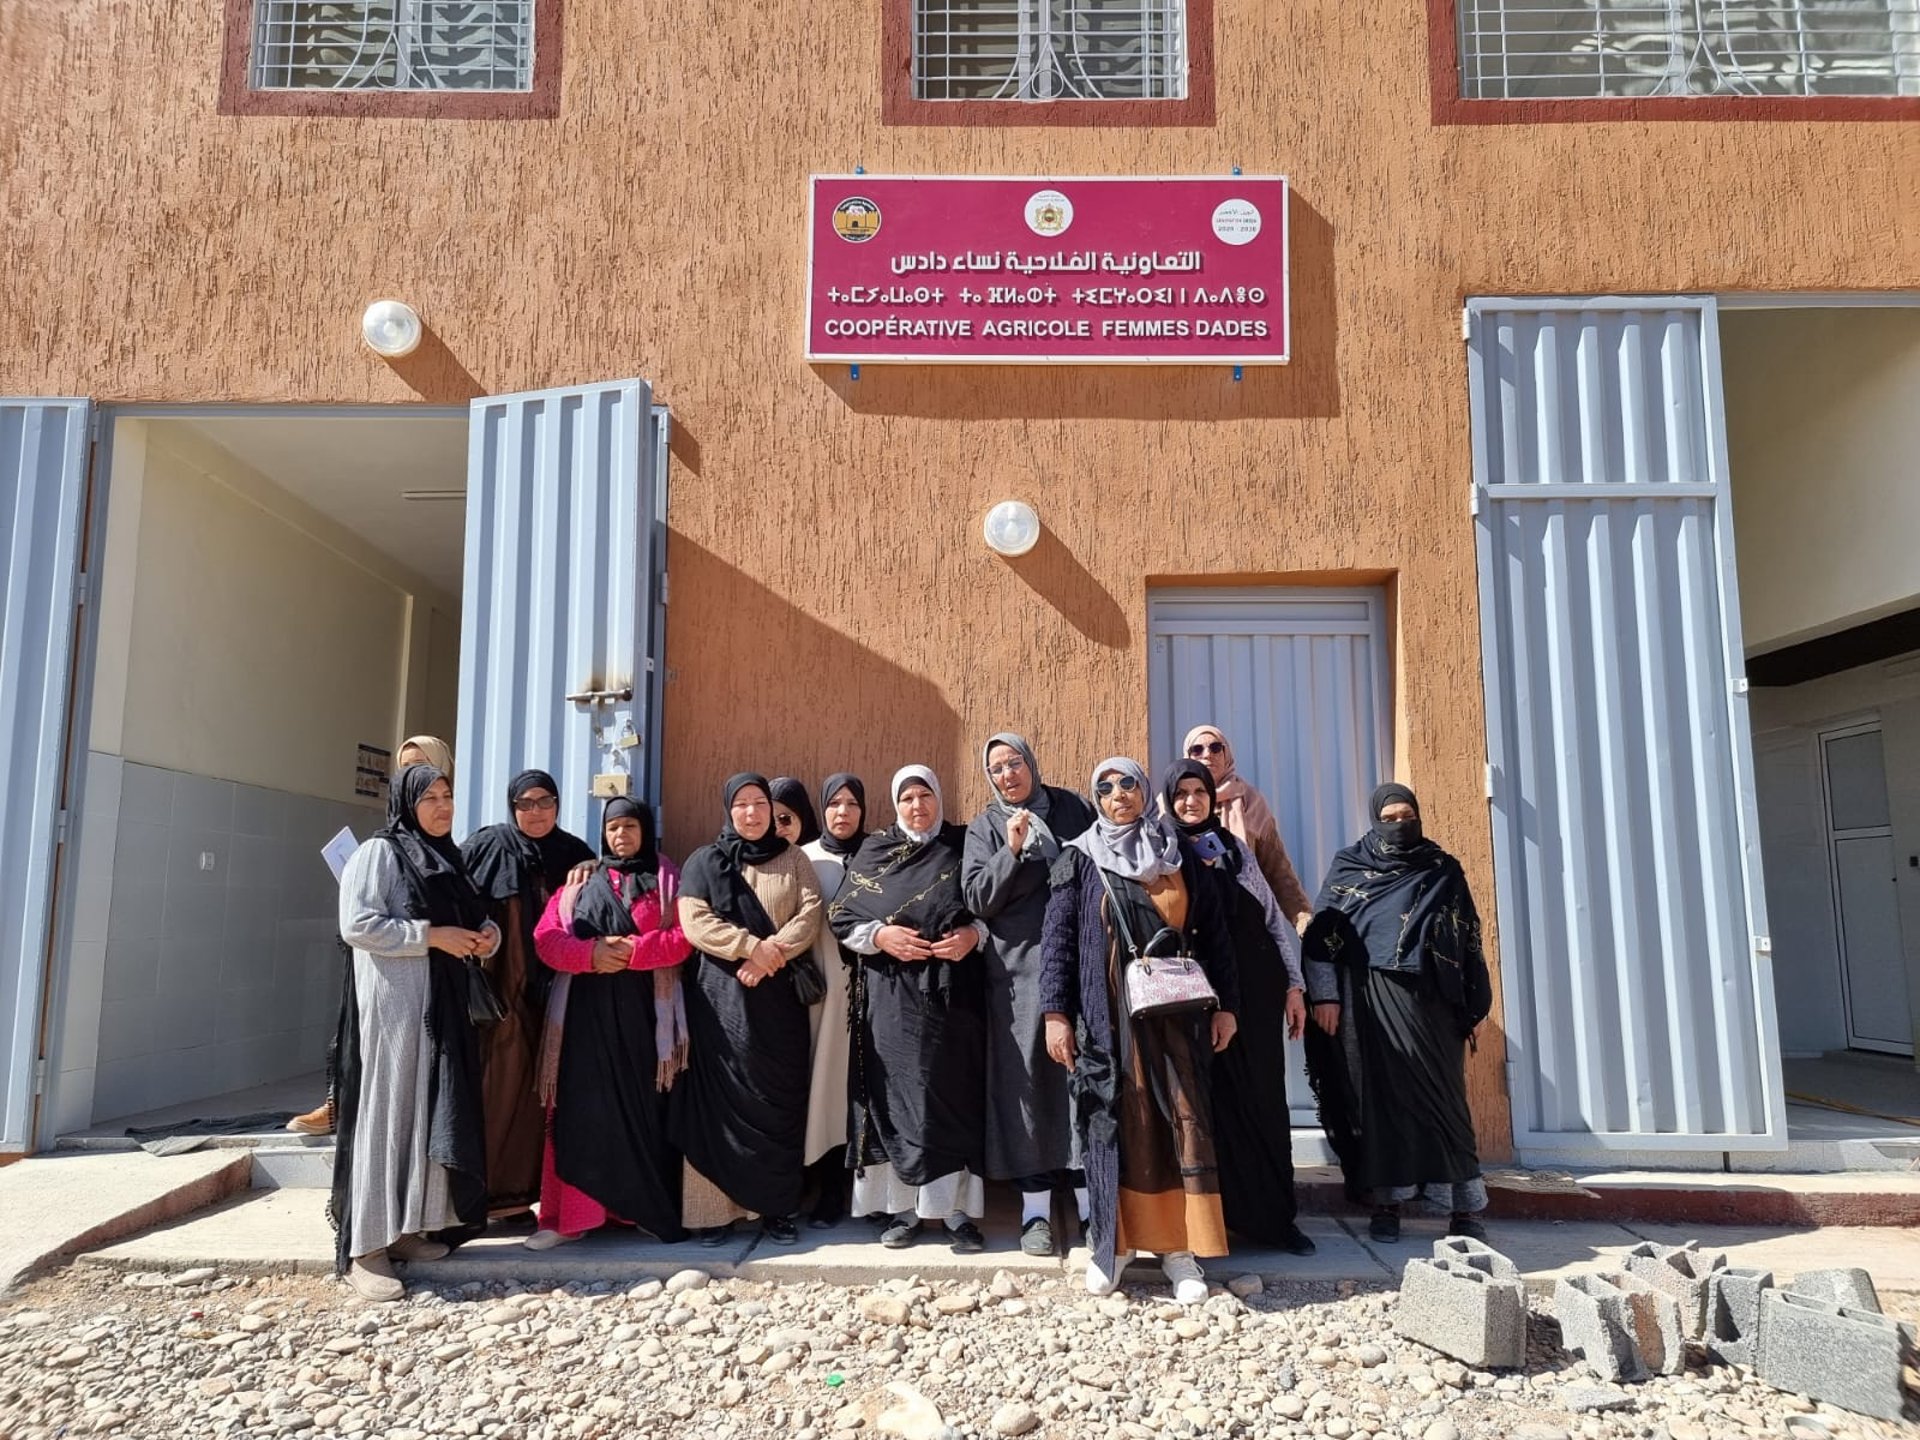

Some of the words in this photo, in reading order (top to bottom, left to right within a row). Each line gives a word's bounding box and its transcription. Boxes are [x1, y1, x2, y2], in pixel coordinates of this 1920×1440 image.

[891, 250, 947, 274] دادس
[951, 250, 1001, 270] نساء
[1005, 250, 1097, 275] الفلاحية
[1101, 250, 1201, 275] التعاونية
[824, 314, 972, 337] COOPÉRATIVE
[981, 319, 1090, 337] AGRICOLE
[1101, 319, 1190, 337] FEMMES
[1195, 319, 1268, 337] DADES
